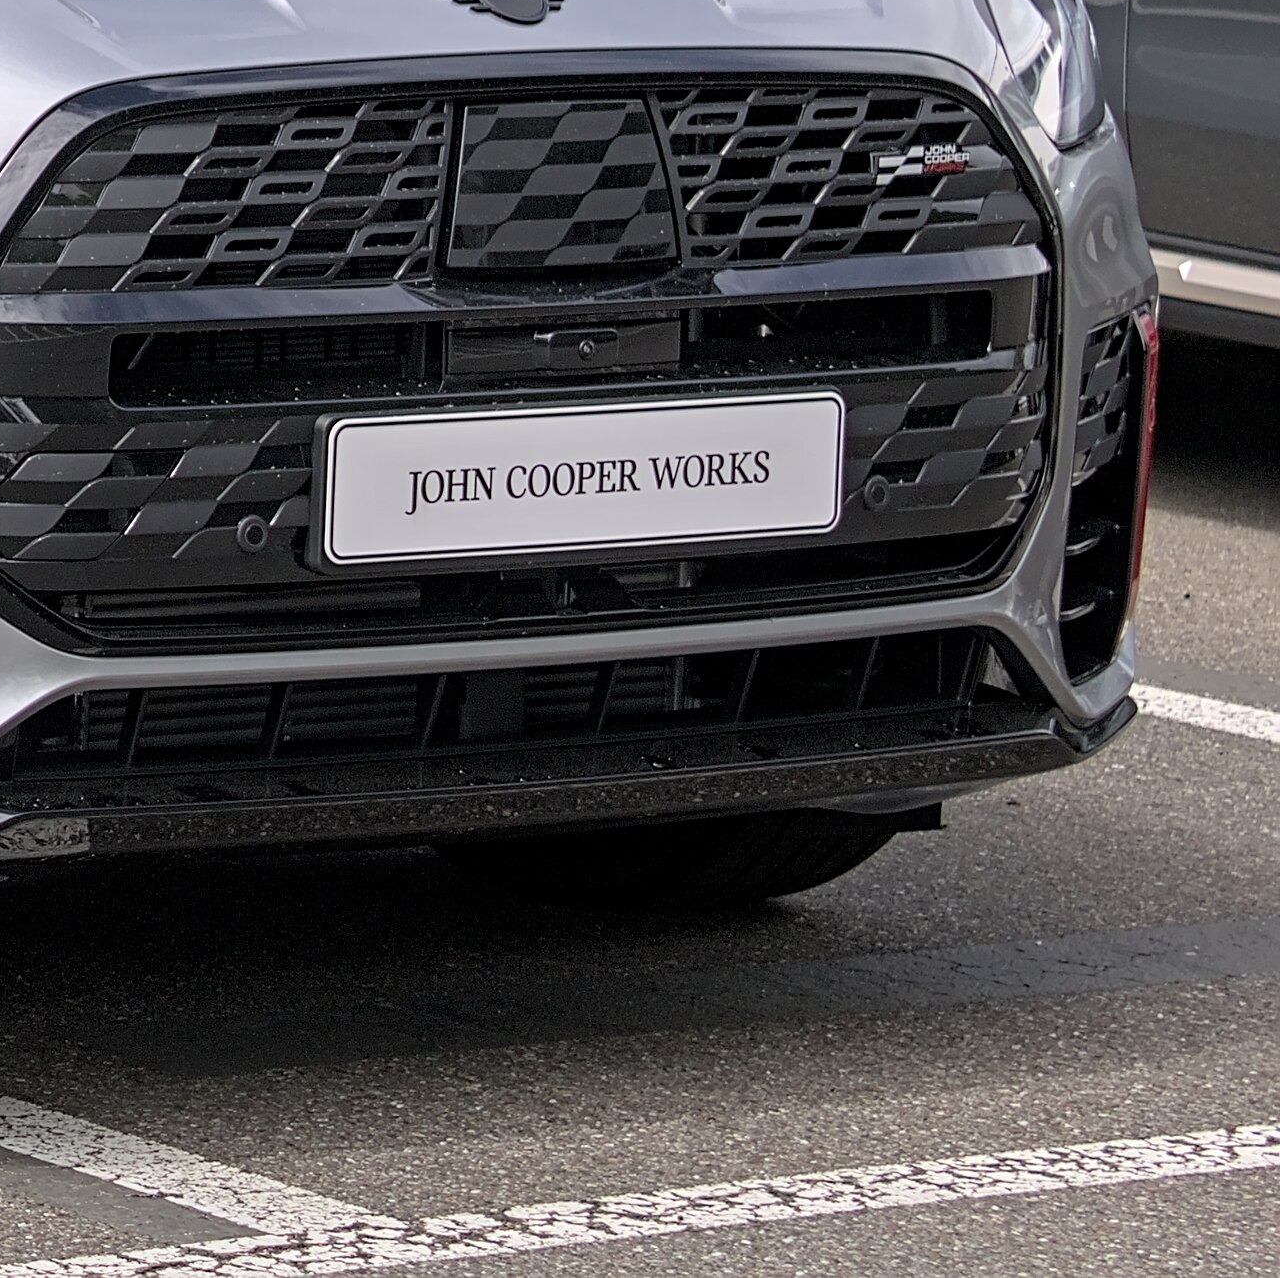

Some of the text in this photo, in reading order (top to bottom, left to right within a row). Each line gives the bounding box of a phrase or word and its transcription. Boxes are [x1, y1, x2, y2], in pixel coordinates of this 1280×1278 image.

[924, 143, 956, 155] JOHN
[925, 152, 970, 164] COOPER
[405, 450, 771, 515] JOHN COOPER WORKS
